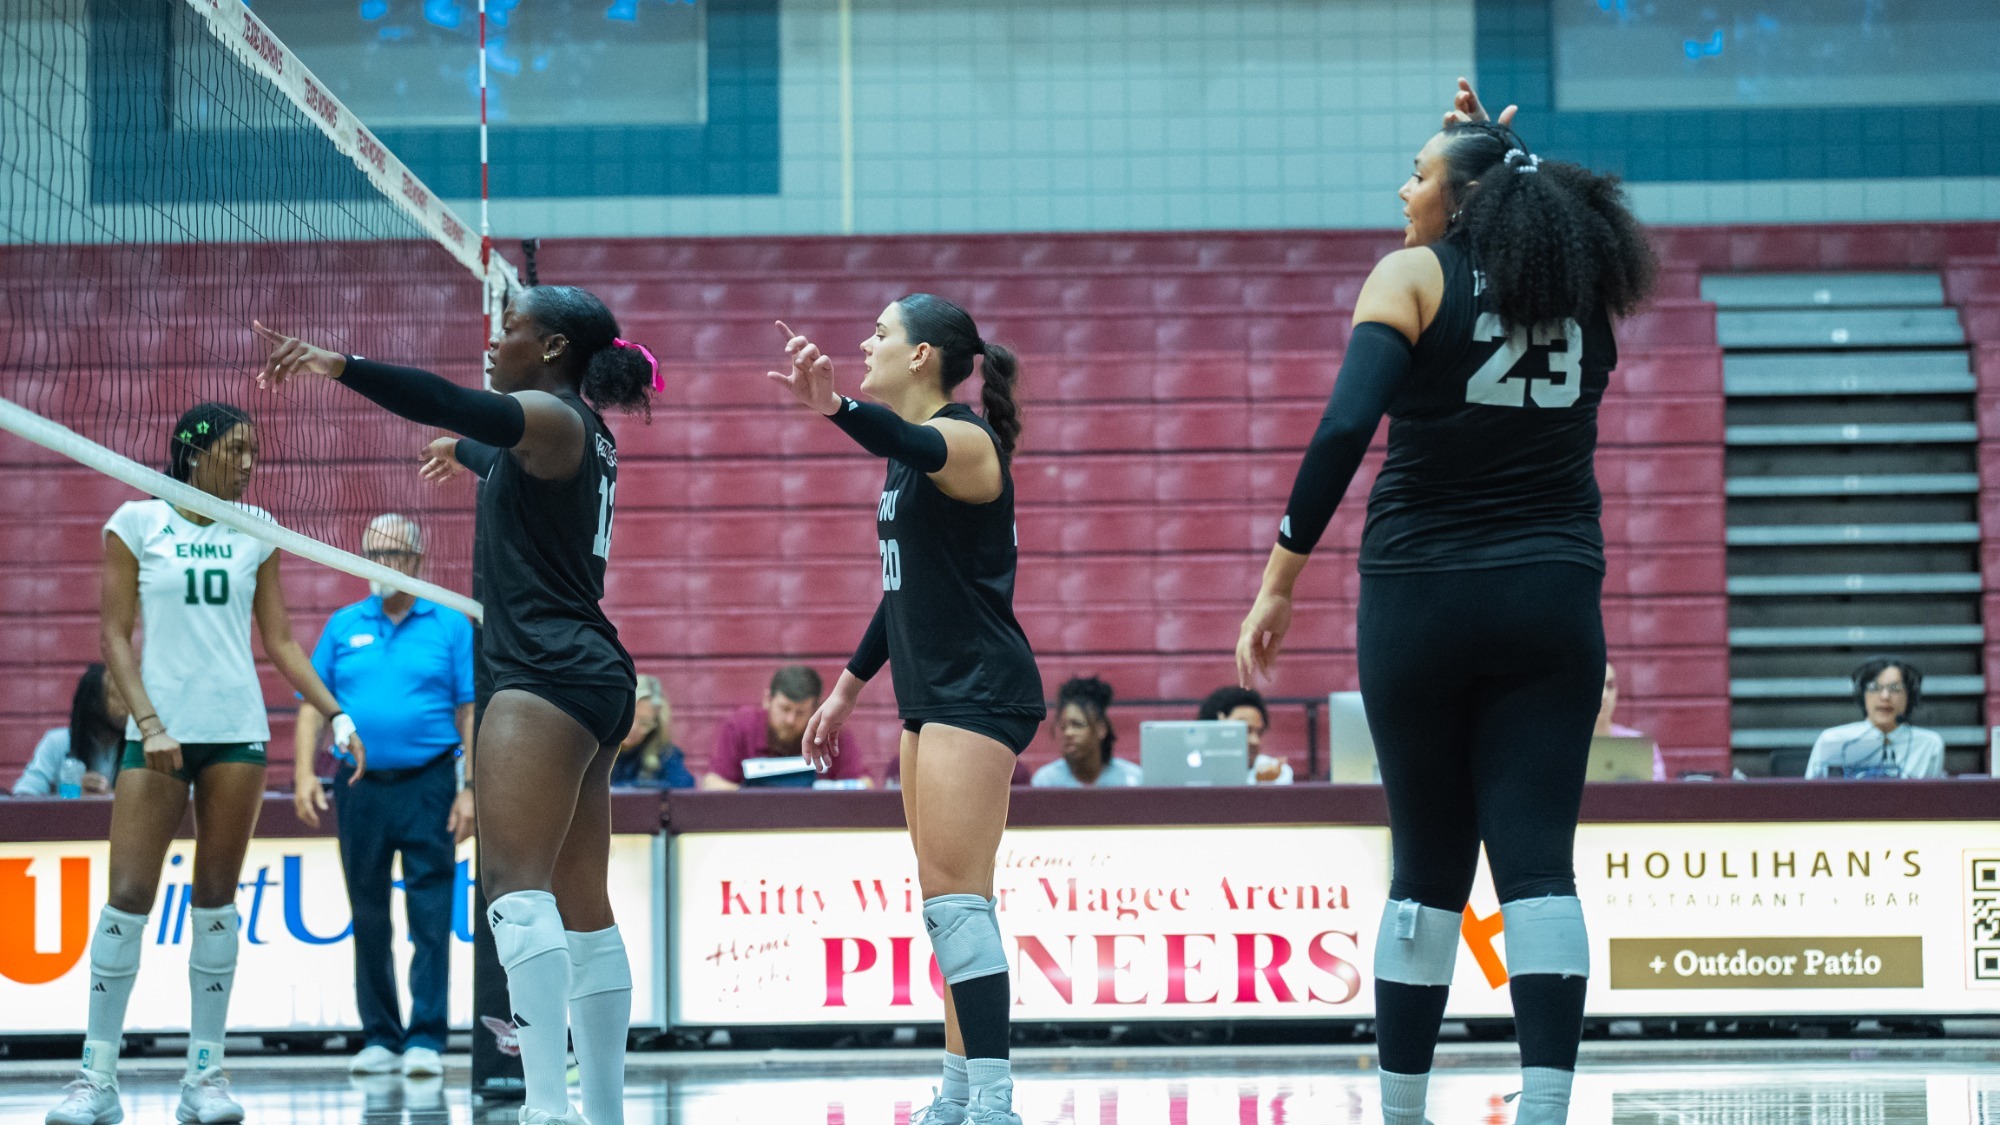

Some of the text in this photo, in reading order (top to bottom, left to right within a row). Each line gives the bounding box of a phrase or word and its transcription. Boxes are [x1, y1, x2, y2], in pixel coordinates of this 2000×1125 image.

[1465, 312, 1583, 408] 23
[176, 543, 232, 559] ENMU
[879, 539, 901, 591] 20
[185, 568, 229, 605] 10
[994, 850, 1075, 868] lcome
[1606, 850, 1921, 879] HOULIHAN'S
[720, 879, 825, 925] Kitty
[1037, 877, 1190, 921] Magee
[1220, 876, 1350, 911] Arena
[1606, 892, 1919, 907] RESTAURANT BAR
[705, 934, 790, 966] Home
[1673, 948, 1797, 976] Outdoor
[1803, 948, 1882, 976] Patio
[820, 930, 1361, 1007] PINEERS
